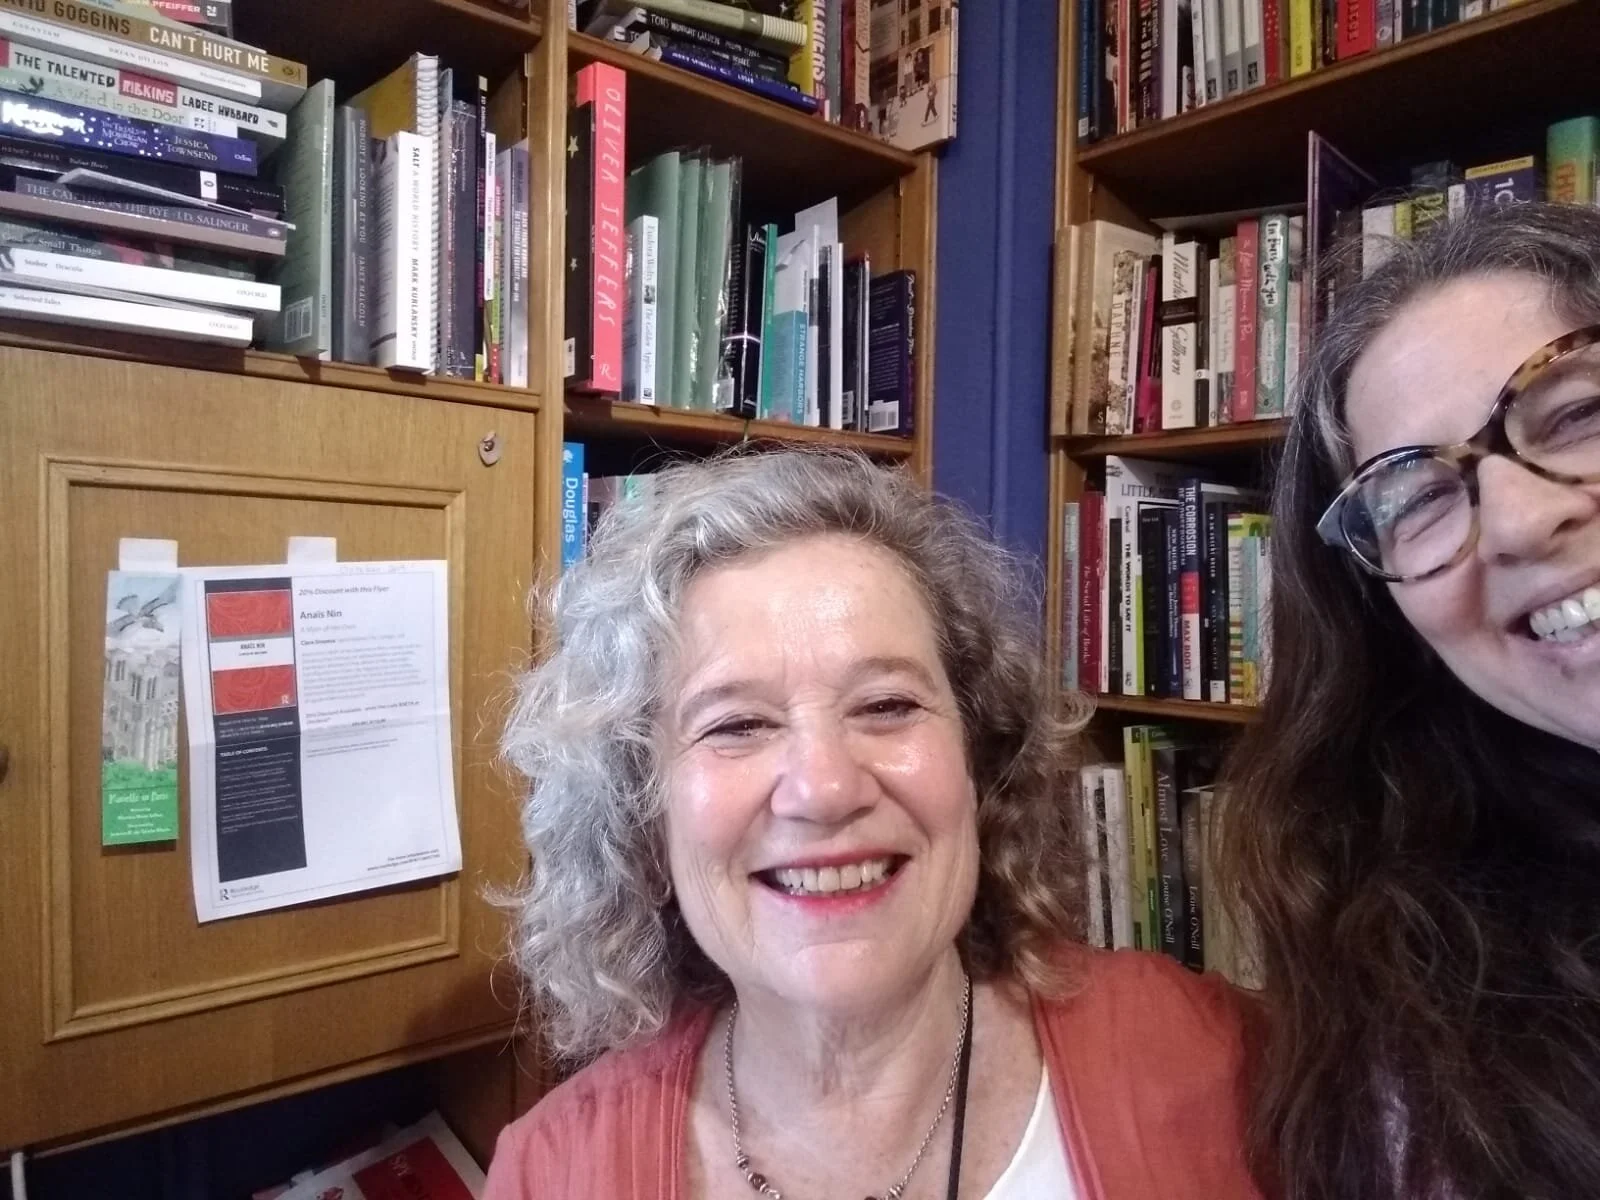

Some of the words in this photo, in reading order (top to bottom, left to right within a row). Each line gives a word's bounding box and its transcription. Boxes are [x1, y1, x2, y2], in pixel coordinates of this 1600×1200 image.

[54, 1, 130, 35] GOGGINS
[151, 27, 196, 53] CAN'T
[203, 41, 242, 65] HURT
[247, 53, 269, 73] ME
[15, 52, 41, 70] THE
[48, 61, 115, 88] TALENTED
[122, 79, 174, 104] RIBKINS
[182, 96, 213, 113] LADEE
[218, 105, 259, 125] HUBBARD
[152, 108, 185, 124] Door
[166, 143, 218, 162] TOWNSEND
[174, 135, 209, 150] JESSICA
[602, 87, 622, 185] OLIVER
[412, 146, 420, 168] SALT
[25, 183, 50, 197] THE
[125, 202, 146, 215] THE
[148, 205, 169, 218] RYE
[196, 215, 249, 232] SALINGER
[360, 211, 366, 223] AT
[39, 239, 65, 250] Small
[411, 258, 419, 283] MARK
[598, 201, 621, 327] JEFFERS
[411, 286, 419, 338] KURLANSKY
[1111, 302, 1123, 358] DAPHNE
[798, 323, 806, 366] STRANGE
[562, 477, 578, 543] Douglas
[1185, 486, 1196, 502] THE
[1185, 504, 1196, 556] CORROSION
[327, 609, 343, 618] Nin
[1125, 594, 1131, 605] TO
[1157, 770, 1172, 823] Almost
[1159, 826, 1173, 862] Love
[1162, 874, 1172, 907] Louise
[1164, 908, 1175, 944] O'Neill
[1189, 916, 1200, 951] O'Neill
